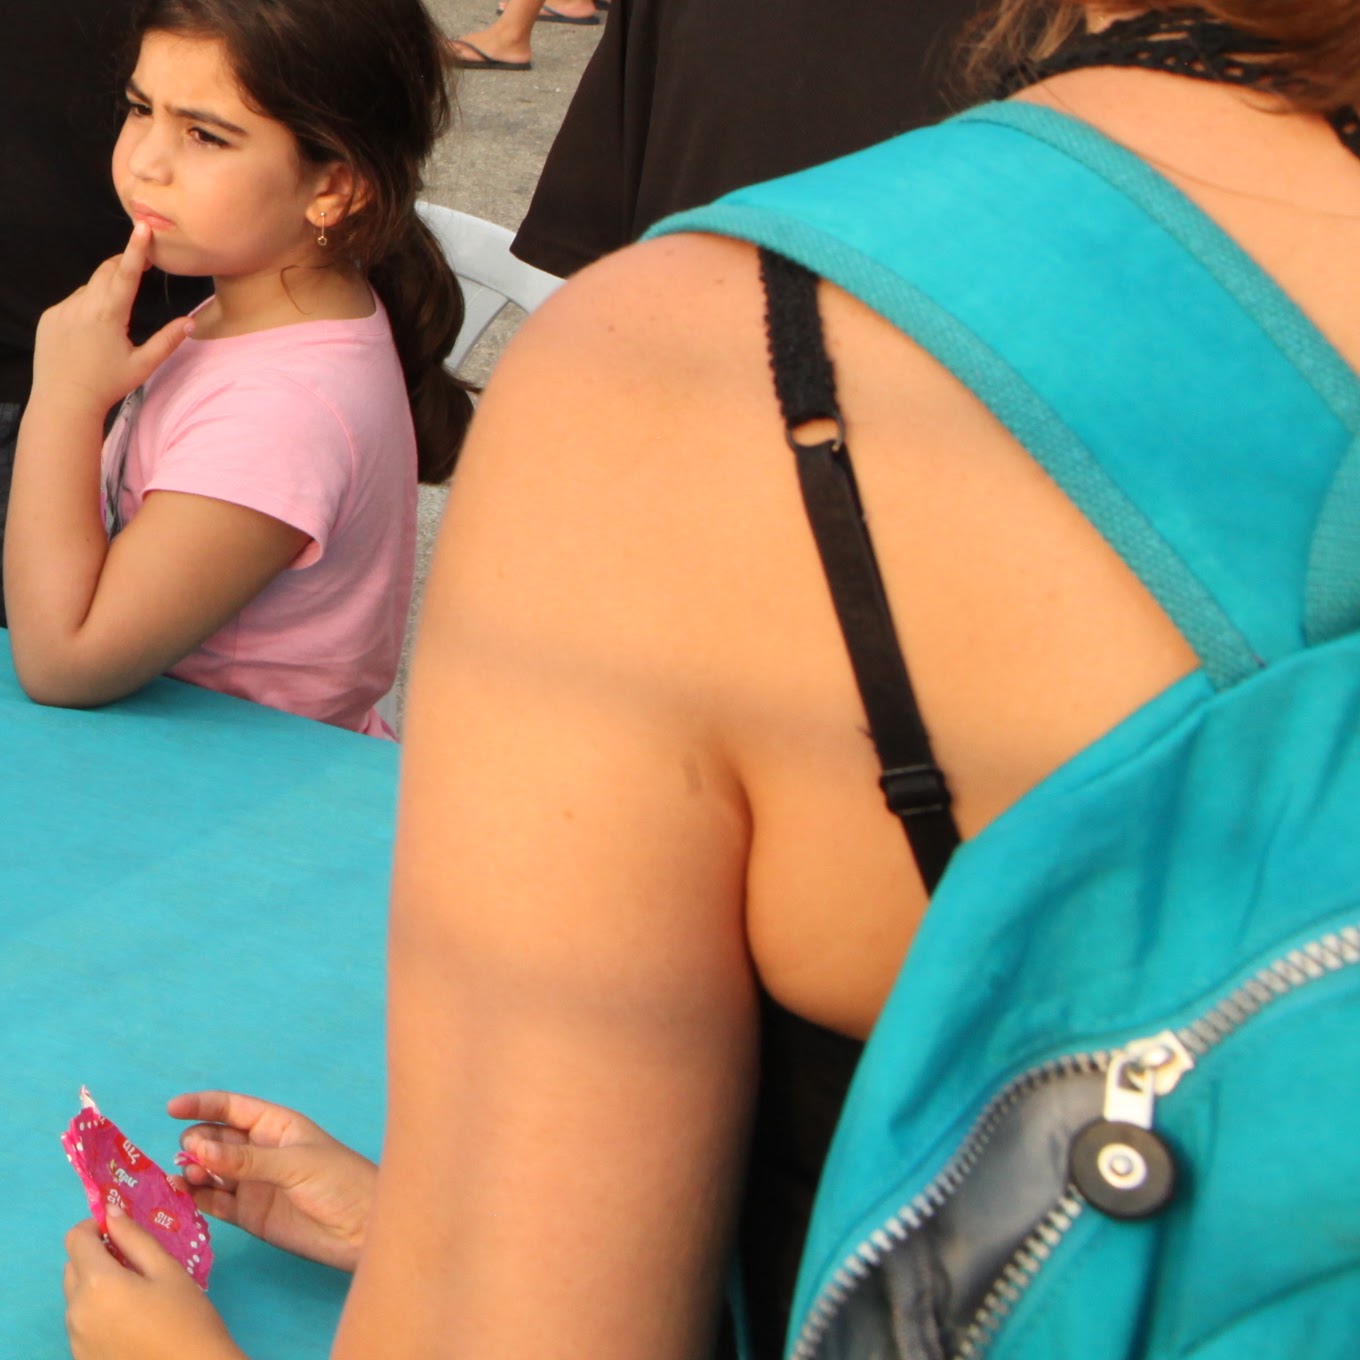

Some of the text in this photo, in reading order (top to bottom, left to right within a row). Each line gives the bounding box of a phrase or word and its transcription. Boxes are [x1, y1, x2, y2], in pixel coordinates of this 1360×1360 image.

[122, 1139, 141, 1165] מזל
[153, 1217, 171, 1229] מזל
[156, 1211, 174, 1224] טוב
